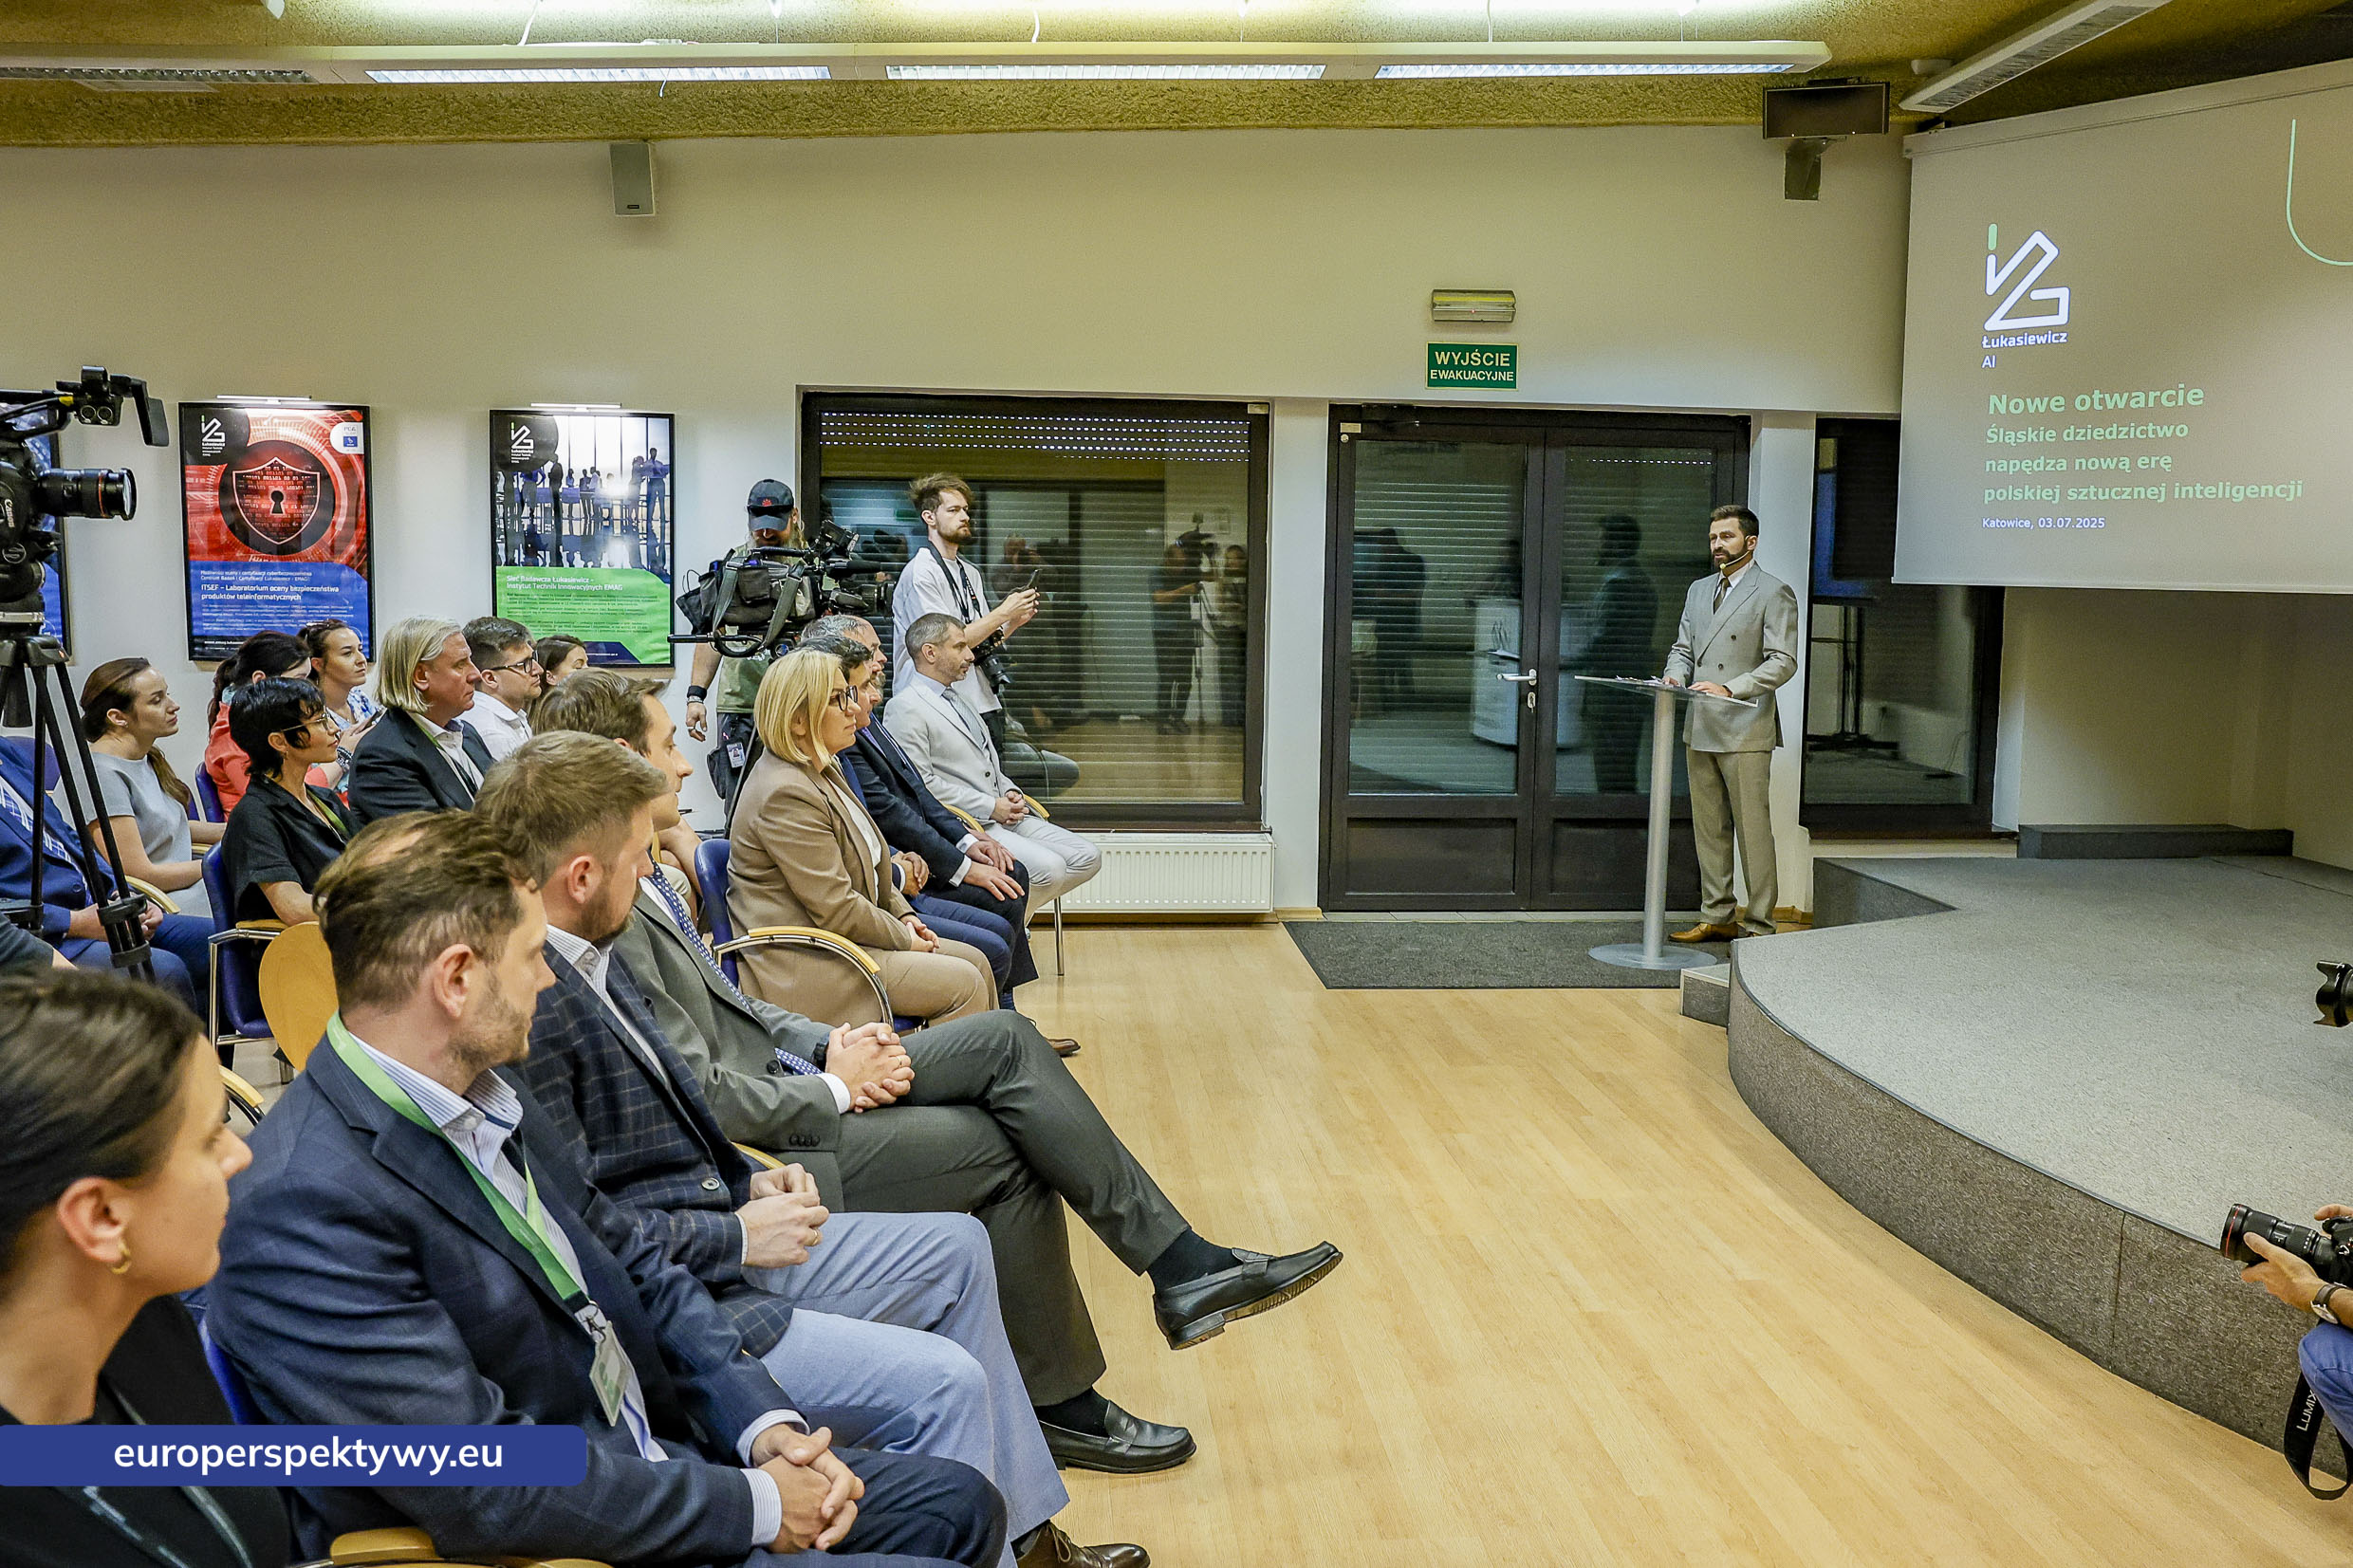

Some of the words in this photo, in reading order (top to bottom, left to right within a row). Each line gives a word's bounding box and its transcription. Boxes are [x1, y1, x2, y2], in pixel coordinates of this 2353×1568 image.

[1982, 331, 2068, 348] Łukasiewicz
[1435, 348, 1510, 367] WYJŚCIE
[1981, 355, 1996, 368] AI
[1430, 369, 1514, 381] EWAKUACYJNE
[1988, 394, 2066, 415] Nowe
[2074, 383, 2205, 411] otwarcie
[1986, 424, 2057, 446] Śląskie
[2063, 423, 2189, 441] dziedzictwo
[1985, 456, 2067, 474] napędza
[2075, 456, 2132, 472] nową
[2137, 455, 2173, 471] erę
[1984, 485, 2061, 504] polskiej
[2067, 483, 2167, 503] sztucznej
[2174, 480, 2303, 502] inteligencji
[5, 498, 15, 527] Canon
[1982, 518, 2034, 529] Katowice,
[2038, 517, 2105, 528] 03.07.2025
[237, 593, 301, 601] teleinformatycznych
[2296, 1390, 2317, 1431] LUMIX
